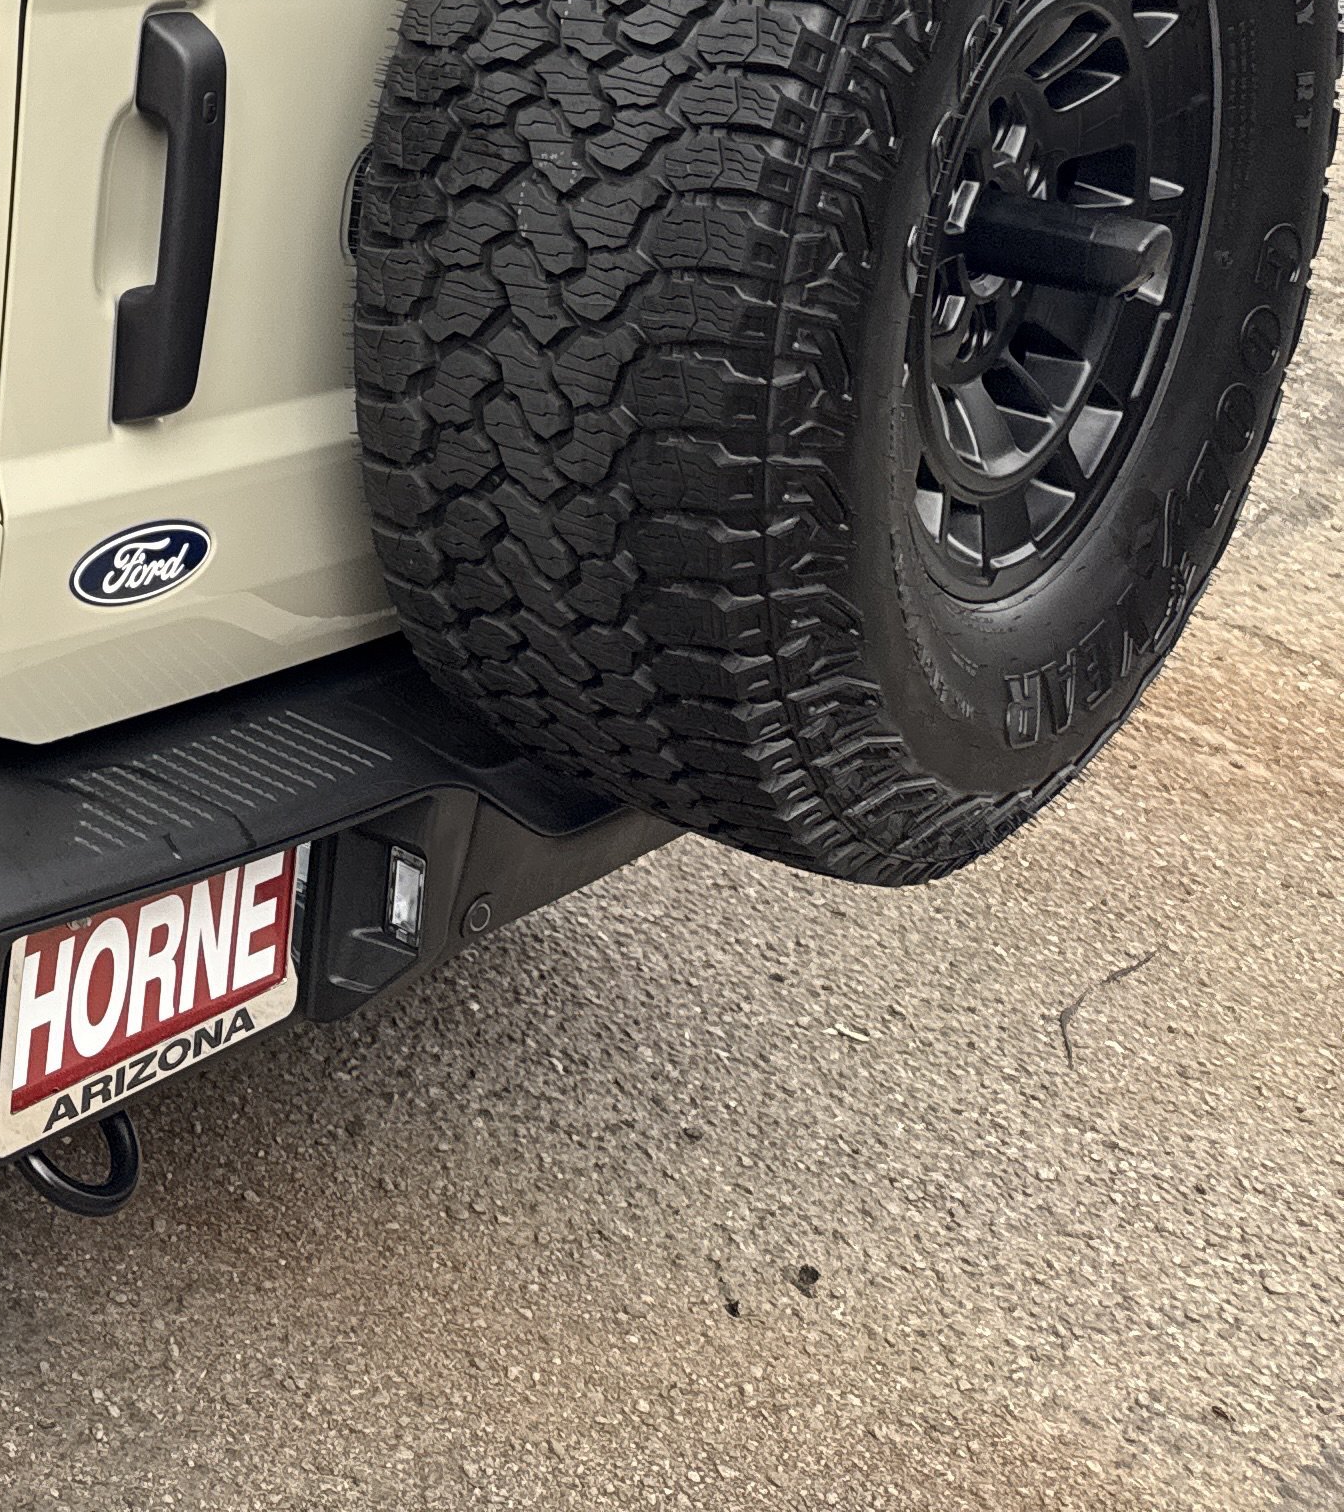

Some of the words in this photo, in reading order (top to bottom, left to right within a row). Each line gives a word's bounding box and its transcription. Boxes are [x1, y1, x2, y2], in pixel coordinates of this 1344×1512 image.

[102, 537, 190, 594] Ford
[12, 850, 286, 1092] HORNE
[43, 1007, 255, 1133] ARIZONA
